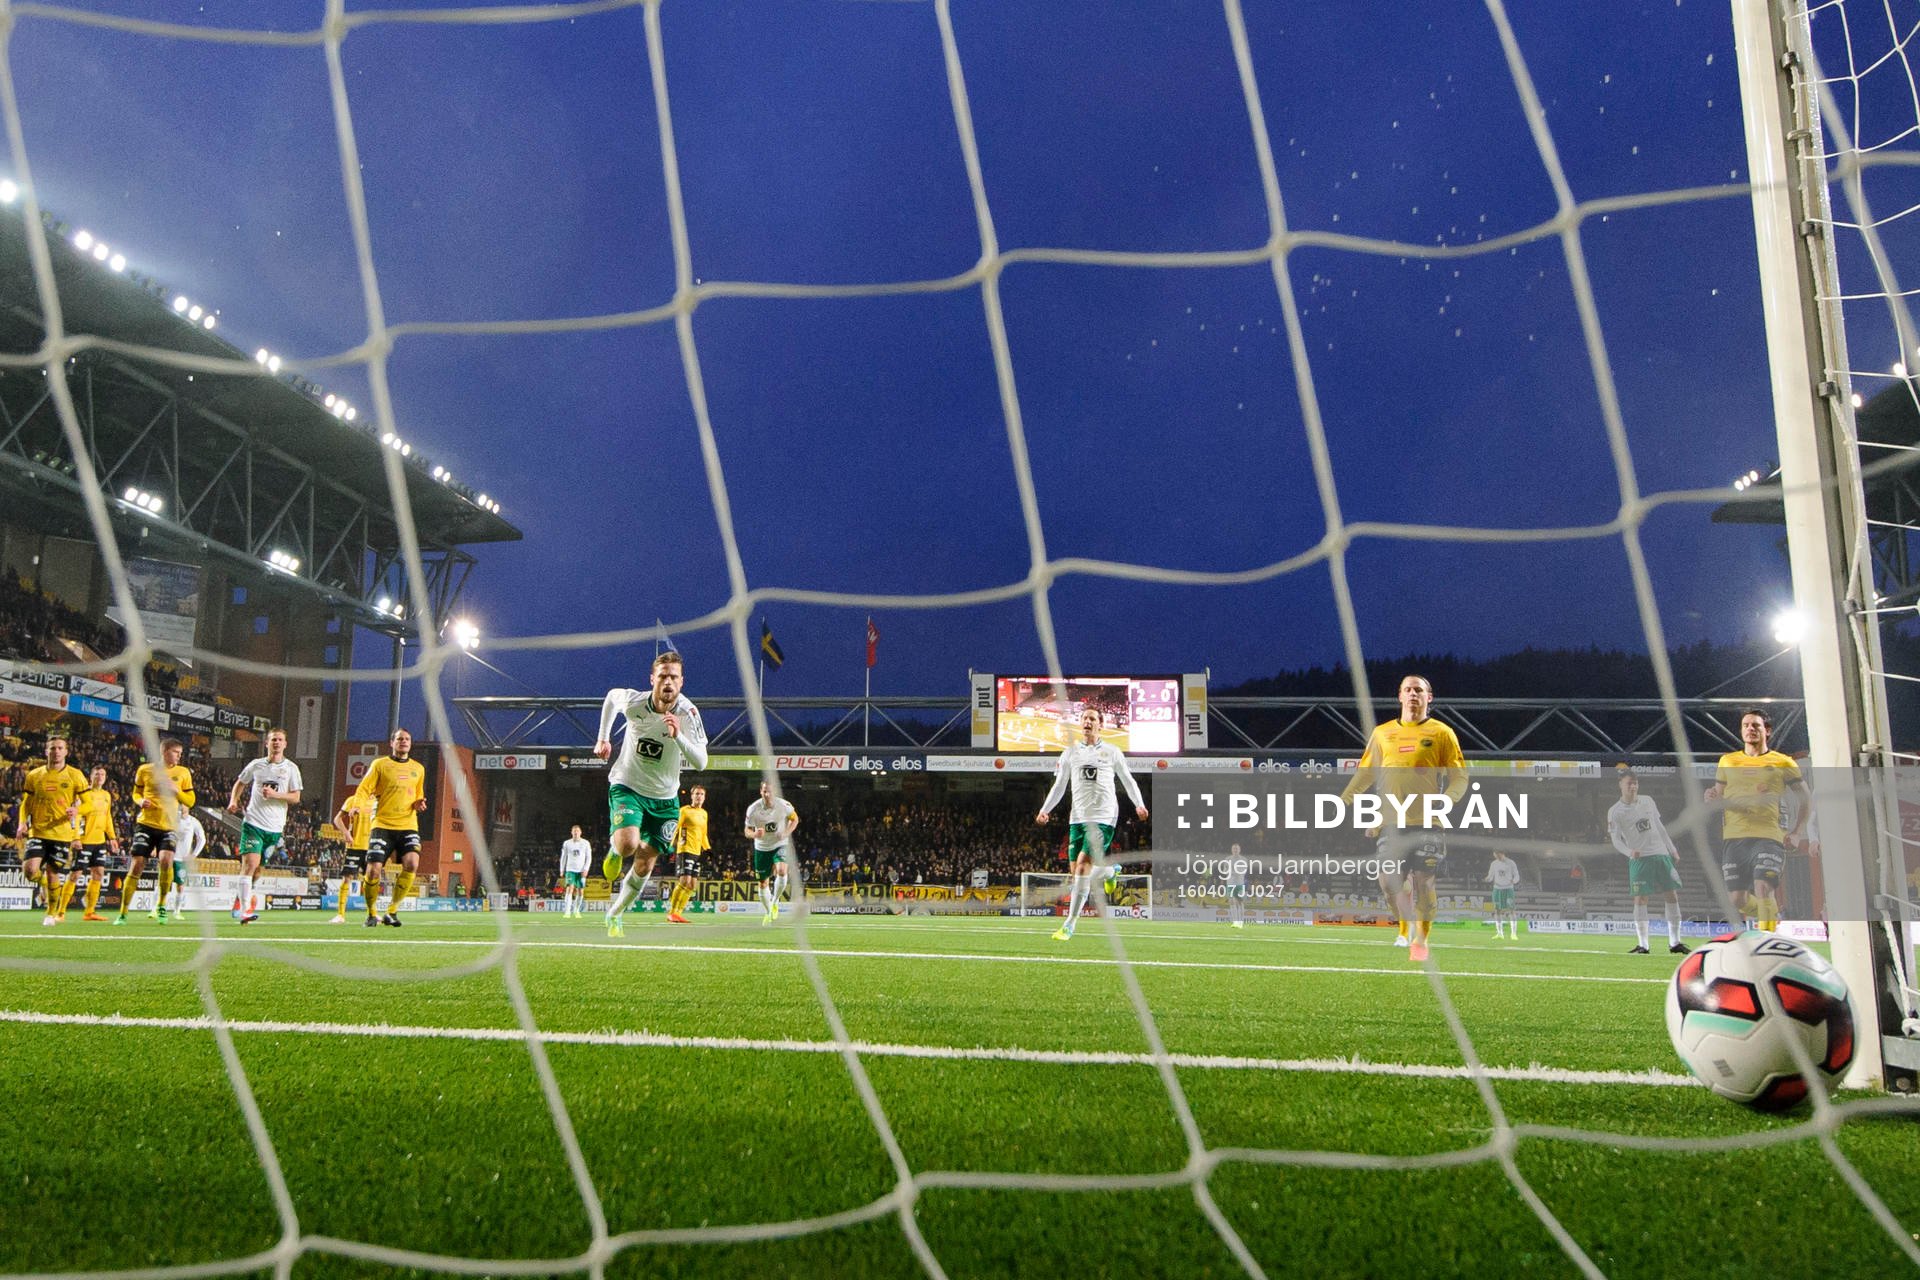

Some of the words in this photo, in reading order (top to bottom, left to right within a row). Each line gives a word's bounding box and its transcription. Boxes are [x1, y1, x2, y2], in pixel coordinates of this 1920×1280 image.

[1137, 688, 1146, 702] 2
[1161, 688, 1170, 702] 0
[1135, 706, 1172, 721] 56:28
[776, 757, 844, 769] PULSEN
[854, 755, 884, 770] ellos
[892, 755, 922, 770] ellos
[1258, 758, 1289, 773] ellos
[1300, 758, 1333, 774] ellos
[811, 905, 856, 914] HERRLJUNGA
